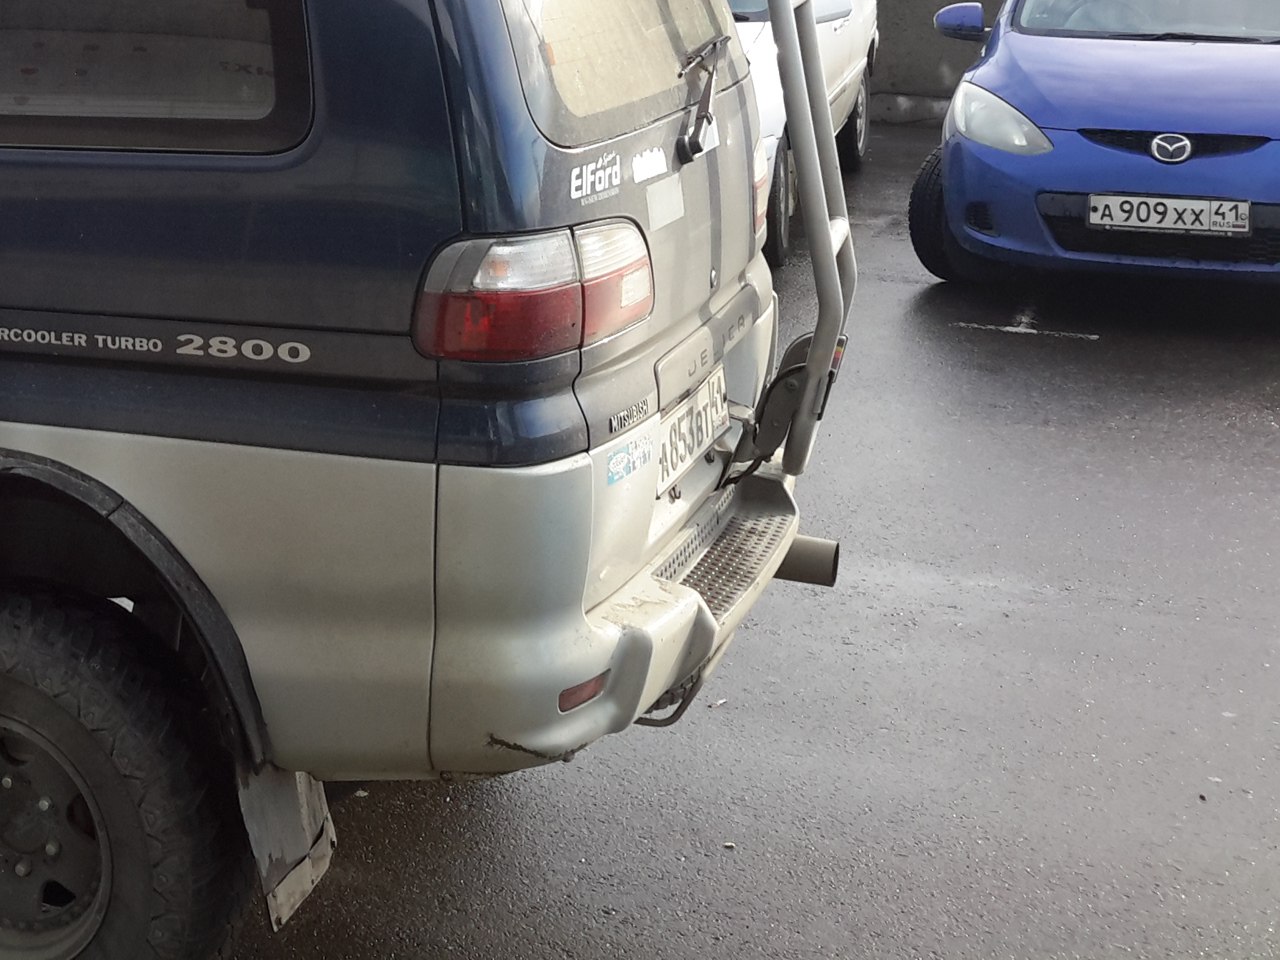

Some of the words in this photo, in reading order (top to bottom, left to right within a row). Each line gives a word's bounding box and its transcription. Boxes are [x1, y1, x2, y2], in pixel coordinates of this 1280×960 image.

[1213, 203, 1240, 222] 41
[1212, 220, 1232, 229] RUS
[94, 333, 164, 353] TURBO
[175, 333, 312, 364] 2800
